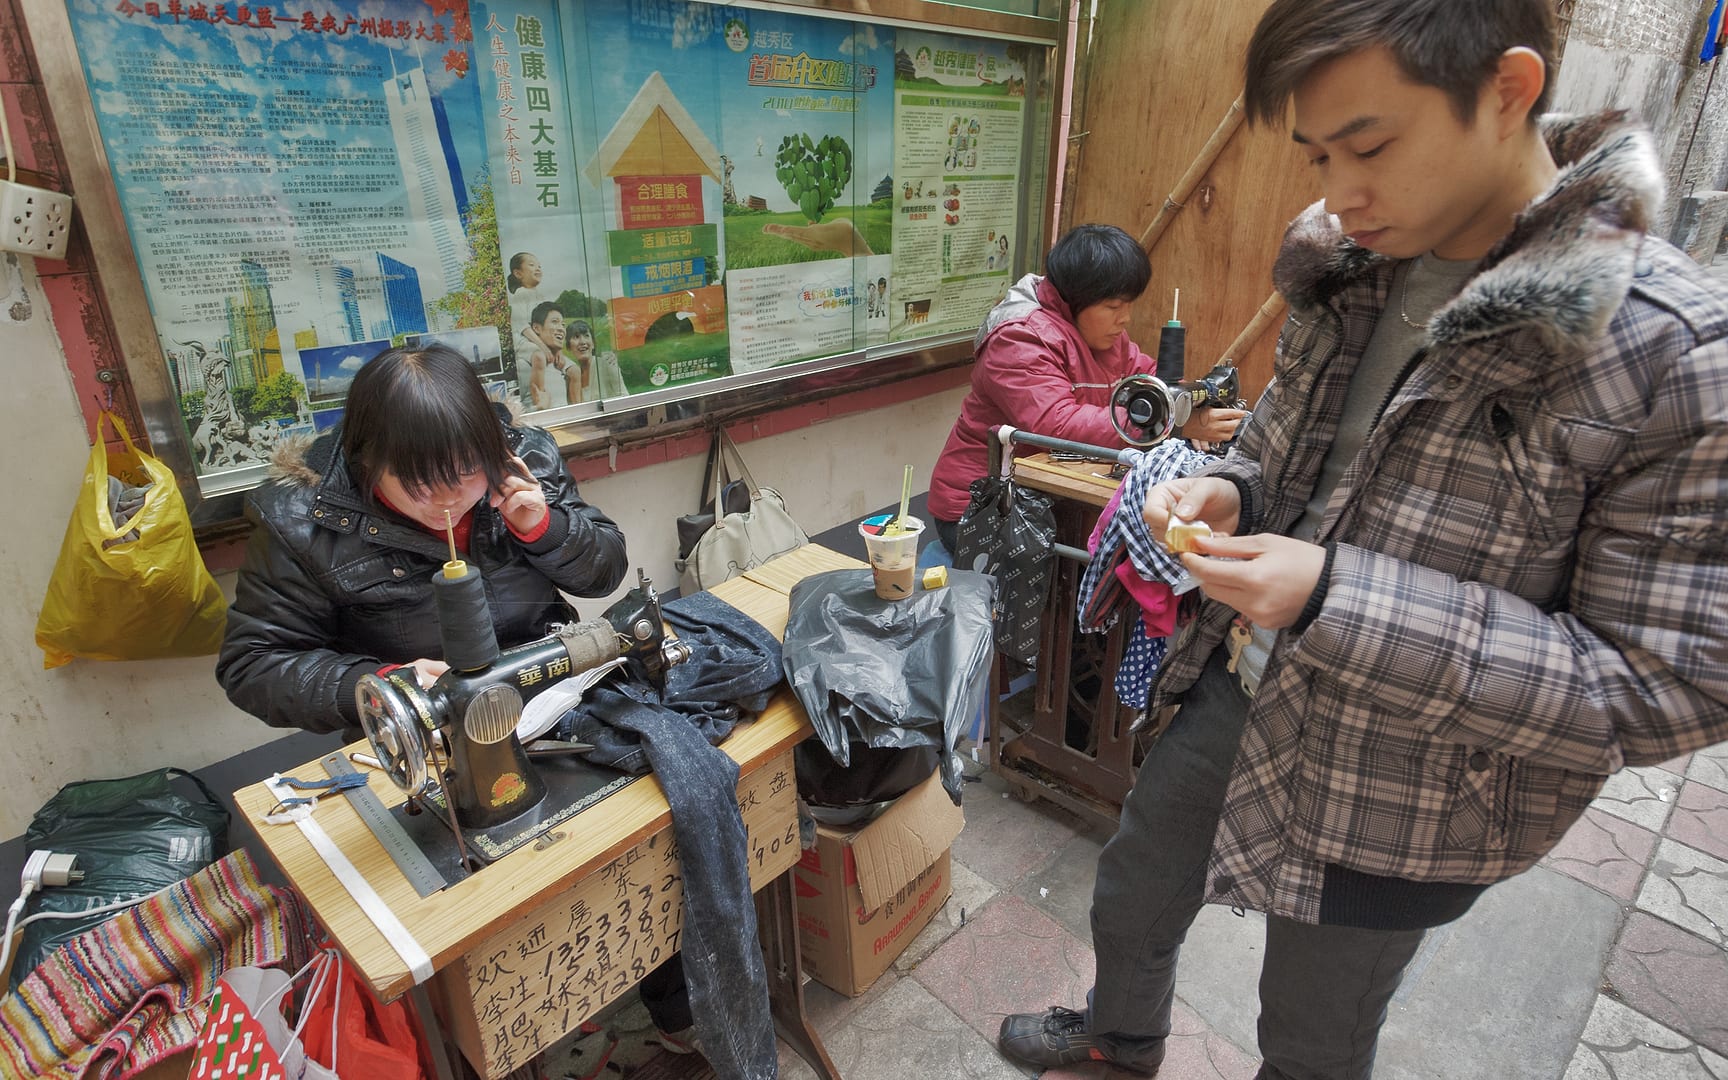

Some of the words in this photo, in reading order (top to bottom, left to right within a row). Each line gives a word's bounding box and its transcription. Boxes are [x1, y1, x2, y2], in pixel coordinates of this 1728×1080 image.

[752, 29, 795, 50] 越秀区
[485, 13, 523, 186] 人生健康之本来自
[515, 15, 560, 208] 健康四大基石
[638, 183, 688, 200] 合理膳食
[642, 229, 692, 249] 适量运动
[645, 260, 693, 280] 戒烟限酒
